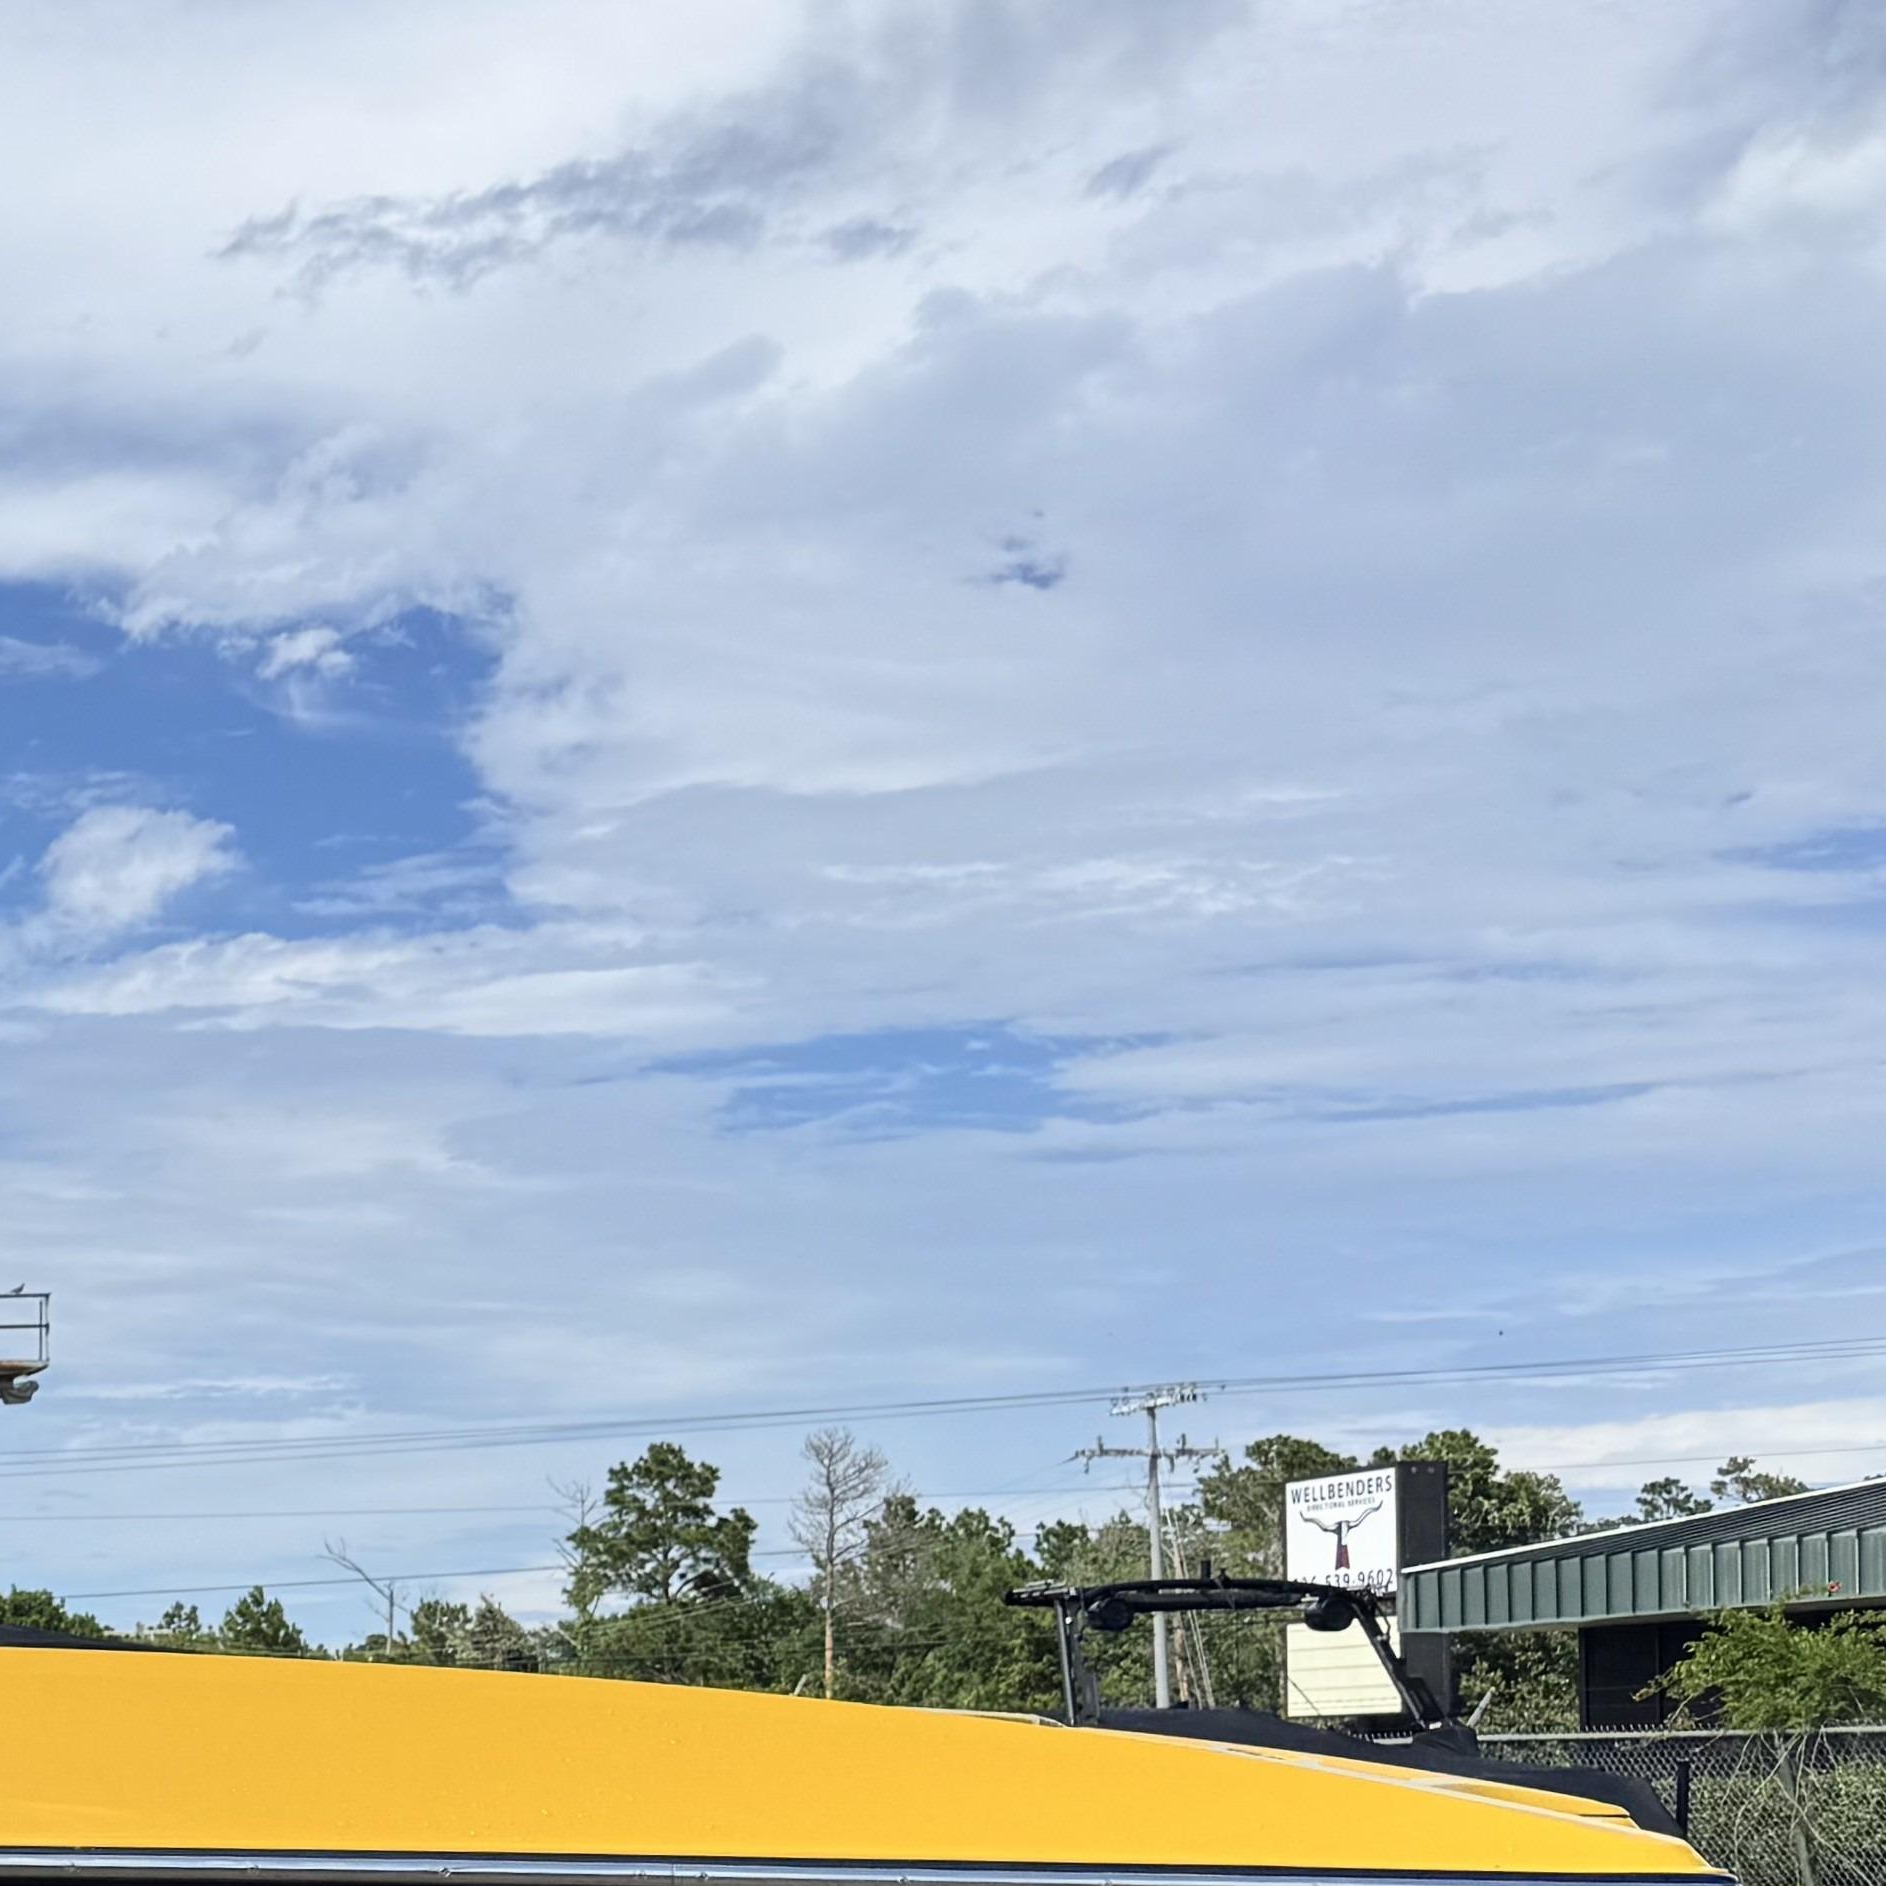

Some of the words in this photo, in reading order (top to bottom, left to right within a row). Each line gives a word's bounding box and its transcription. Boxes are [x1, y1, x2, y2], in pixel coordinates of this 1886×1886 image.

[1291, 1475, 1392, 1504] WELLBENDERS
[1307, 1502, 1345, 1512] DIRECTIONAL
[1347, 1497, 1375, 1507] SERVICES
